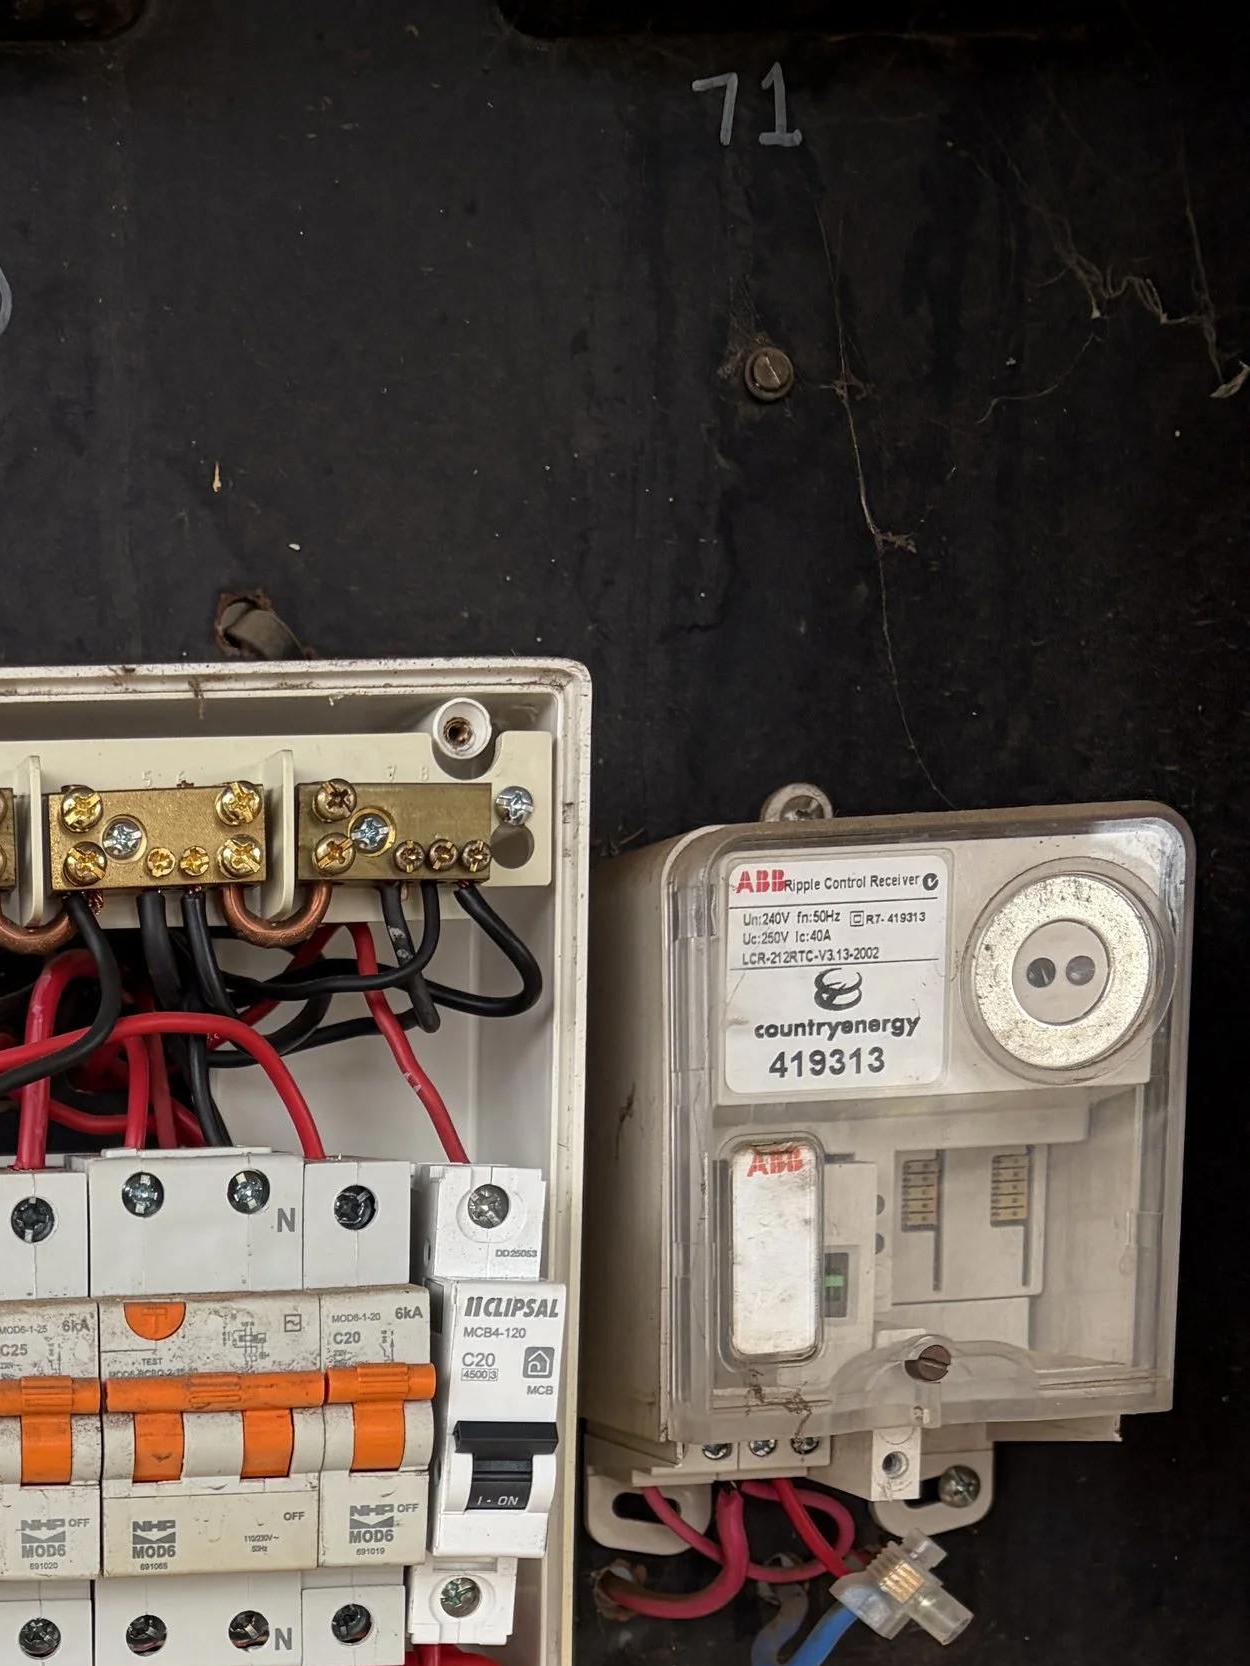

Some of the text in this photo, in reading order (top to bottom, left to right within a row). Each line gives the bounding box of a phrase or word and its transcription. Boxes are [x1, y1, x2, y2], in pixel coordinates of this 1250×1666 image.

[692, 61, 803, 147] 71
[736, 869, 921, 894] ABB Ripple Control Receiver
[742, 909, 927, 927] Un:240V fn:50Hz 419313
[742, 930, 790, 946] Uc:250V
[753, 1015, 922, 1042] countryenergy
[768, 1046, 886, 1079] 419313
[746, 1146, 805, 1178] ABB
[276, 1207, 296, 1233] N
[394, 1306, 424, 1321] 6kA
[61, 1319, 91, 1333] 6kA
[462, 1326, 528, 1340] MCB4-120
[332, 1331, 362, 1345] C20
[0, 1344, 29, 1357] C25
[141, 1357, 163, 1367] TEST
[461, 1351, 496, 1369] C20
[463, 1369, 488, 1381] 4500
[526, 1384, 555, 1397] MCB
[497, 1495, 520, 1506] ON
[282, 1511, 306, 1522] OFF
[349, 1503, 419, 1517] NHP OFF
[20, 1517, 91, 1531] NHP OFF
[131, 1519, 177, 1533] NHP
[348, 1528, 395, 1545] MOD6
[21, 1544, 67, 1559] MOD6
[132, 1544, 177, 1560] MOD6
[274, 1627, 293, 1651] N
